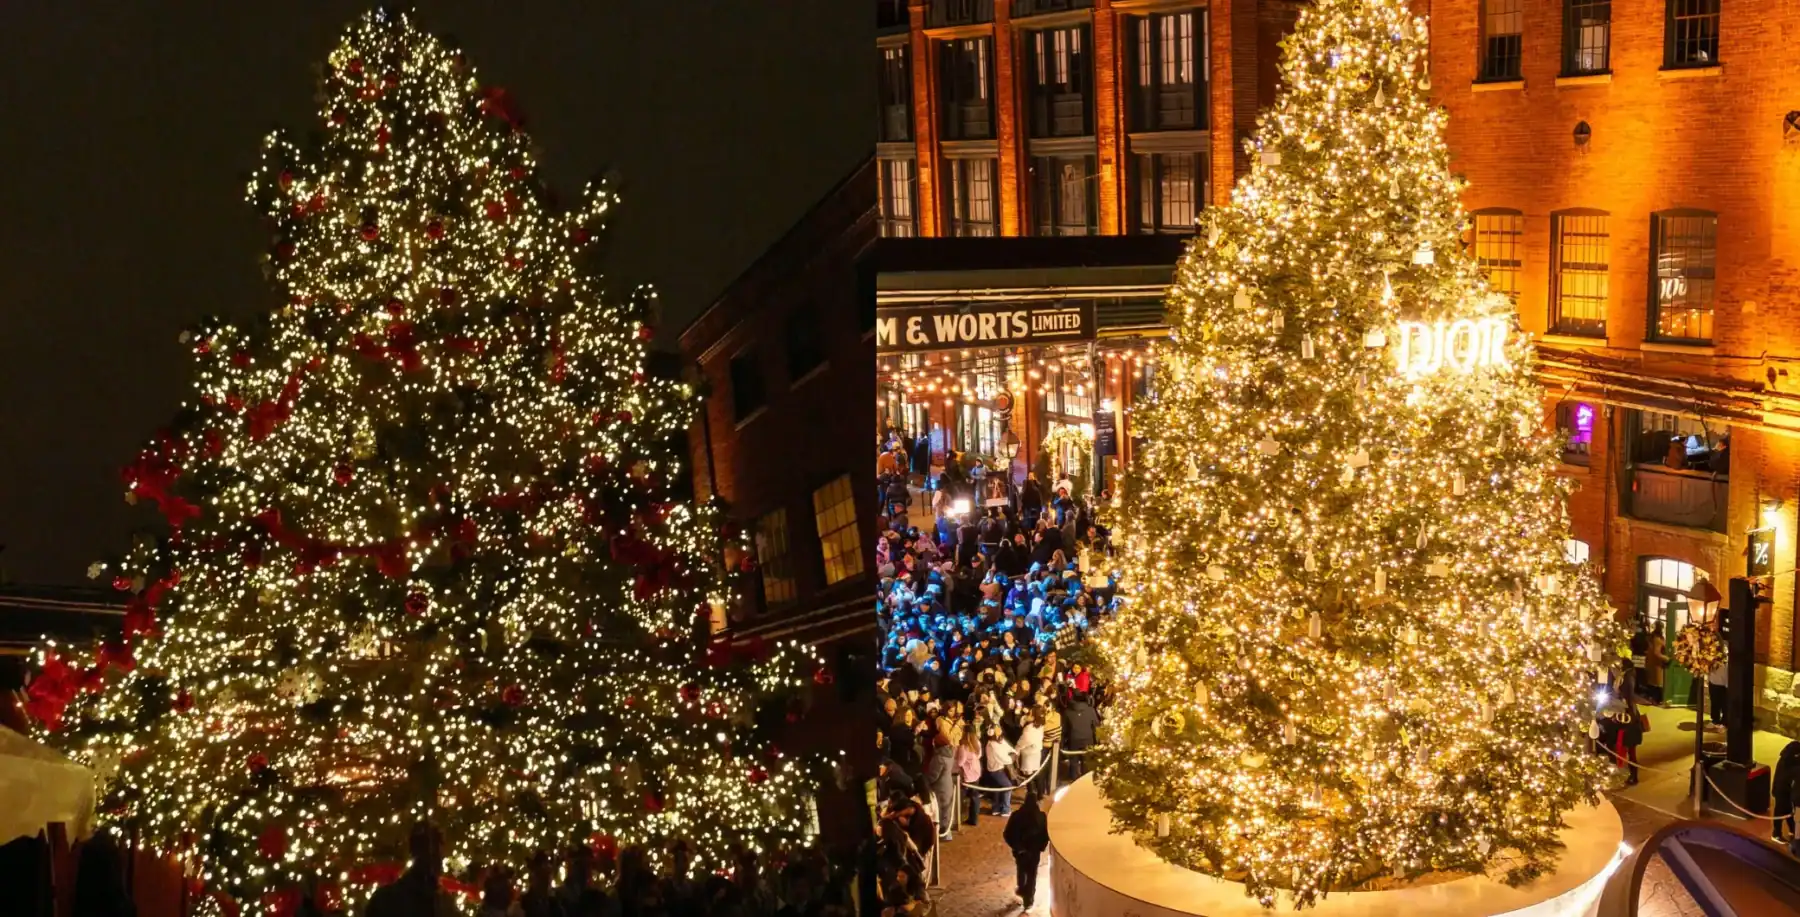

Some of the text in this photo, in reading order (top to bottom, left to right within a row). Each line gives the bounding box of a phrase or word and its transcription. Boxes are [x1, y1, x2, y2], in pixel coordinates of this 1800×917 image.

[906, 316, 929, 344] &
[933, 311, 1029, 343] WORTS
[1032, 313, 1080, 331] LIMITED
[1398, 318, 1512, 378] DIOR
